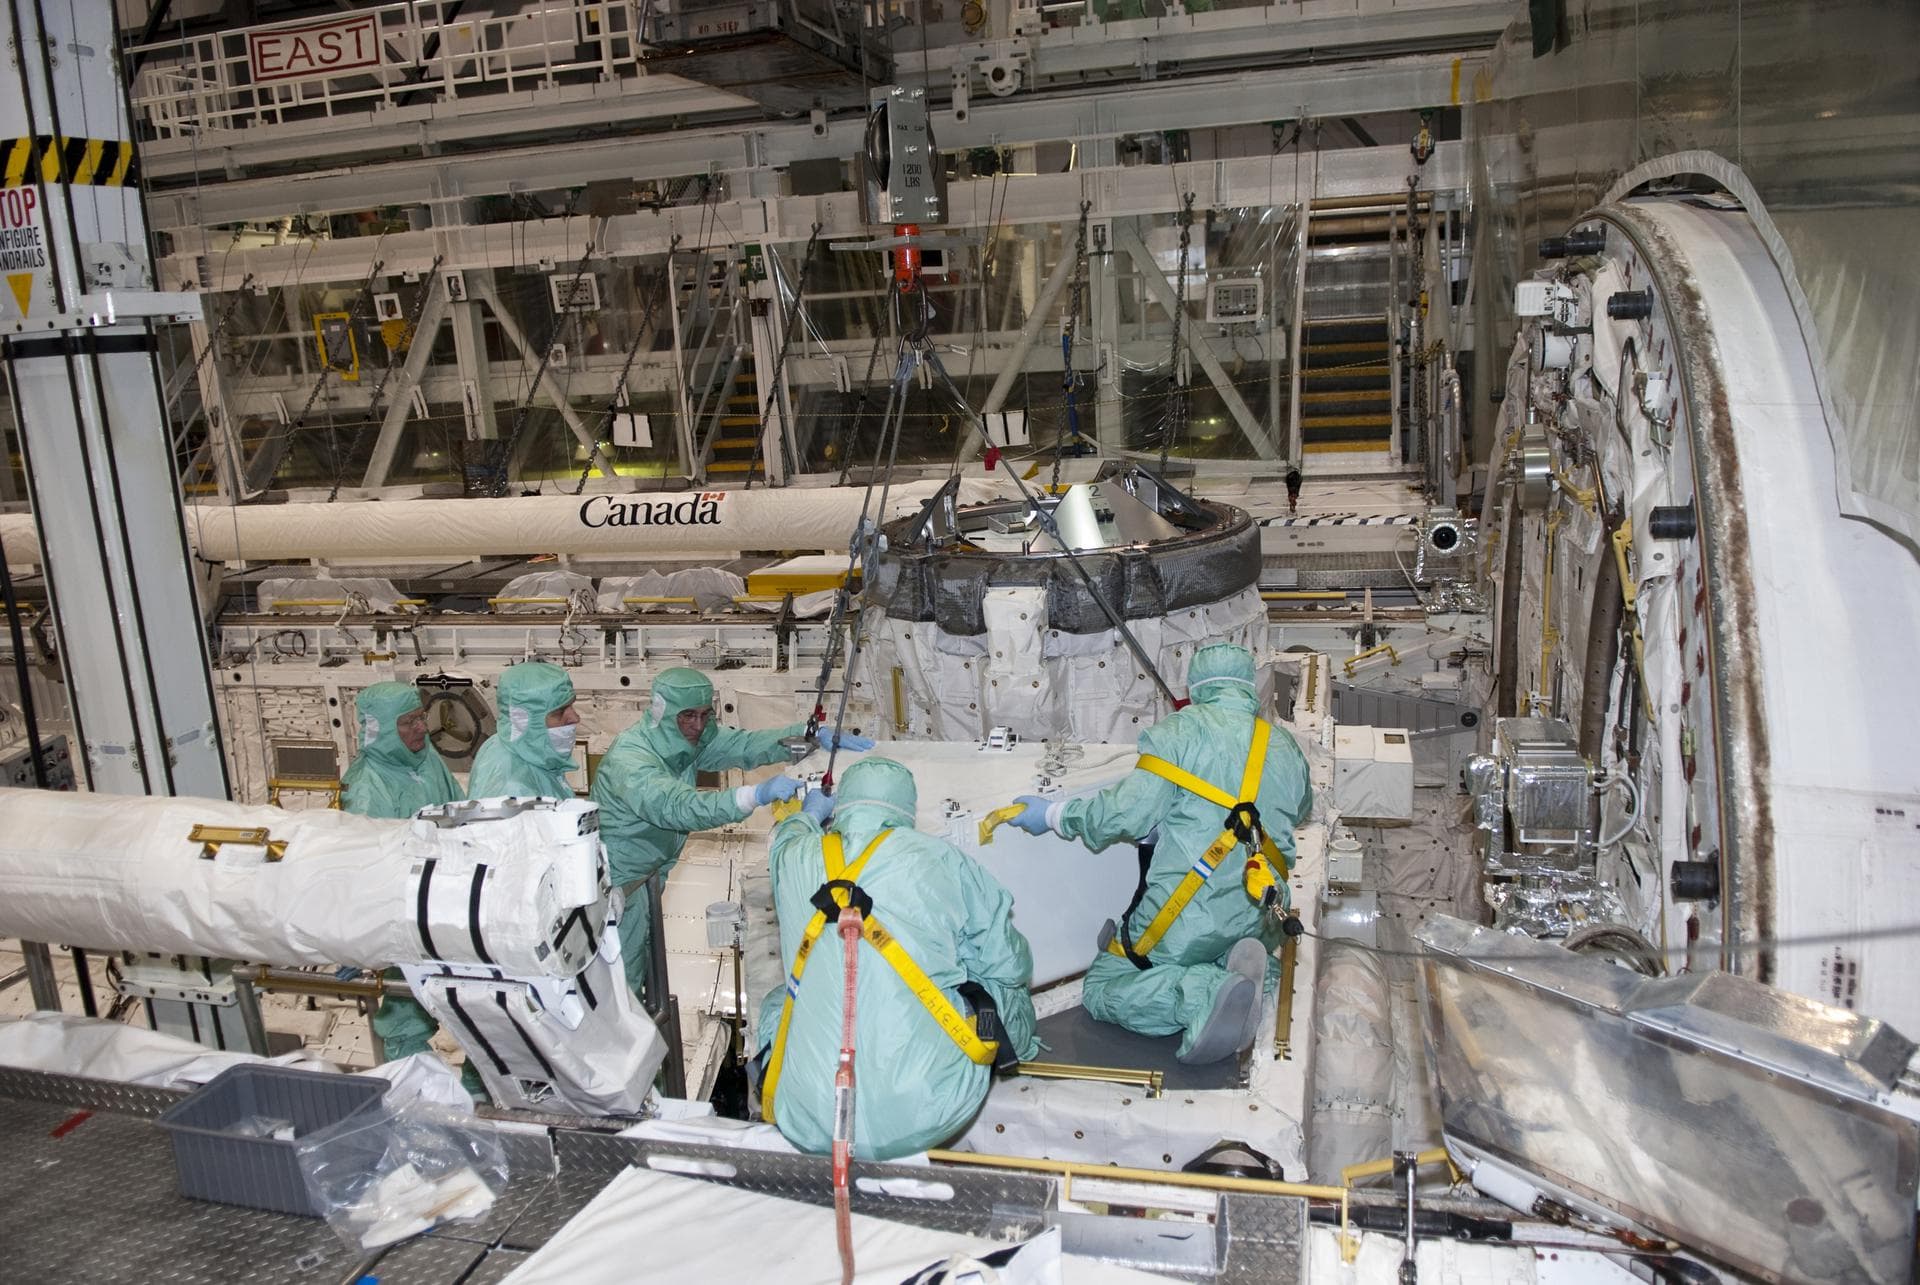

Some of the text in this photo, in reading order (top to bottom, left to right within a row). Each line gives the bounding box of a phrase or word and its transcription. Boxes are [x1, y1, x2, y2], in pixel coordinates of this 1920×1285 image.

[257, 23, 371, 73] EAST
[902, 163, 922, 175] 1200
[904, 176, 921, 188] LBS
[0, 187, 36, 230] TOP
[0, 226, 41, 250] NFIGURE
[0, 247, 46, 272] NDRAILS
[1088, 484, 1102, 497] 2
[579, 492, 722, 528] Canada
